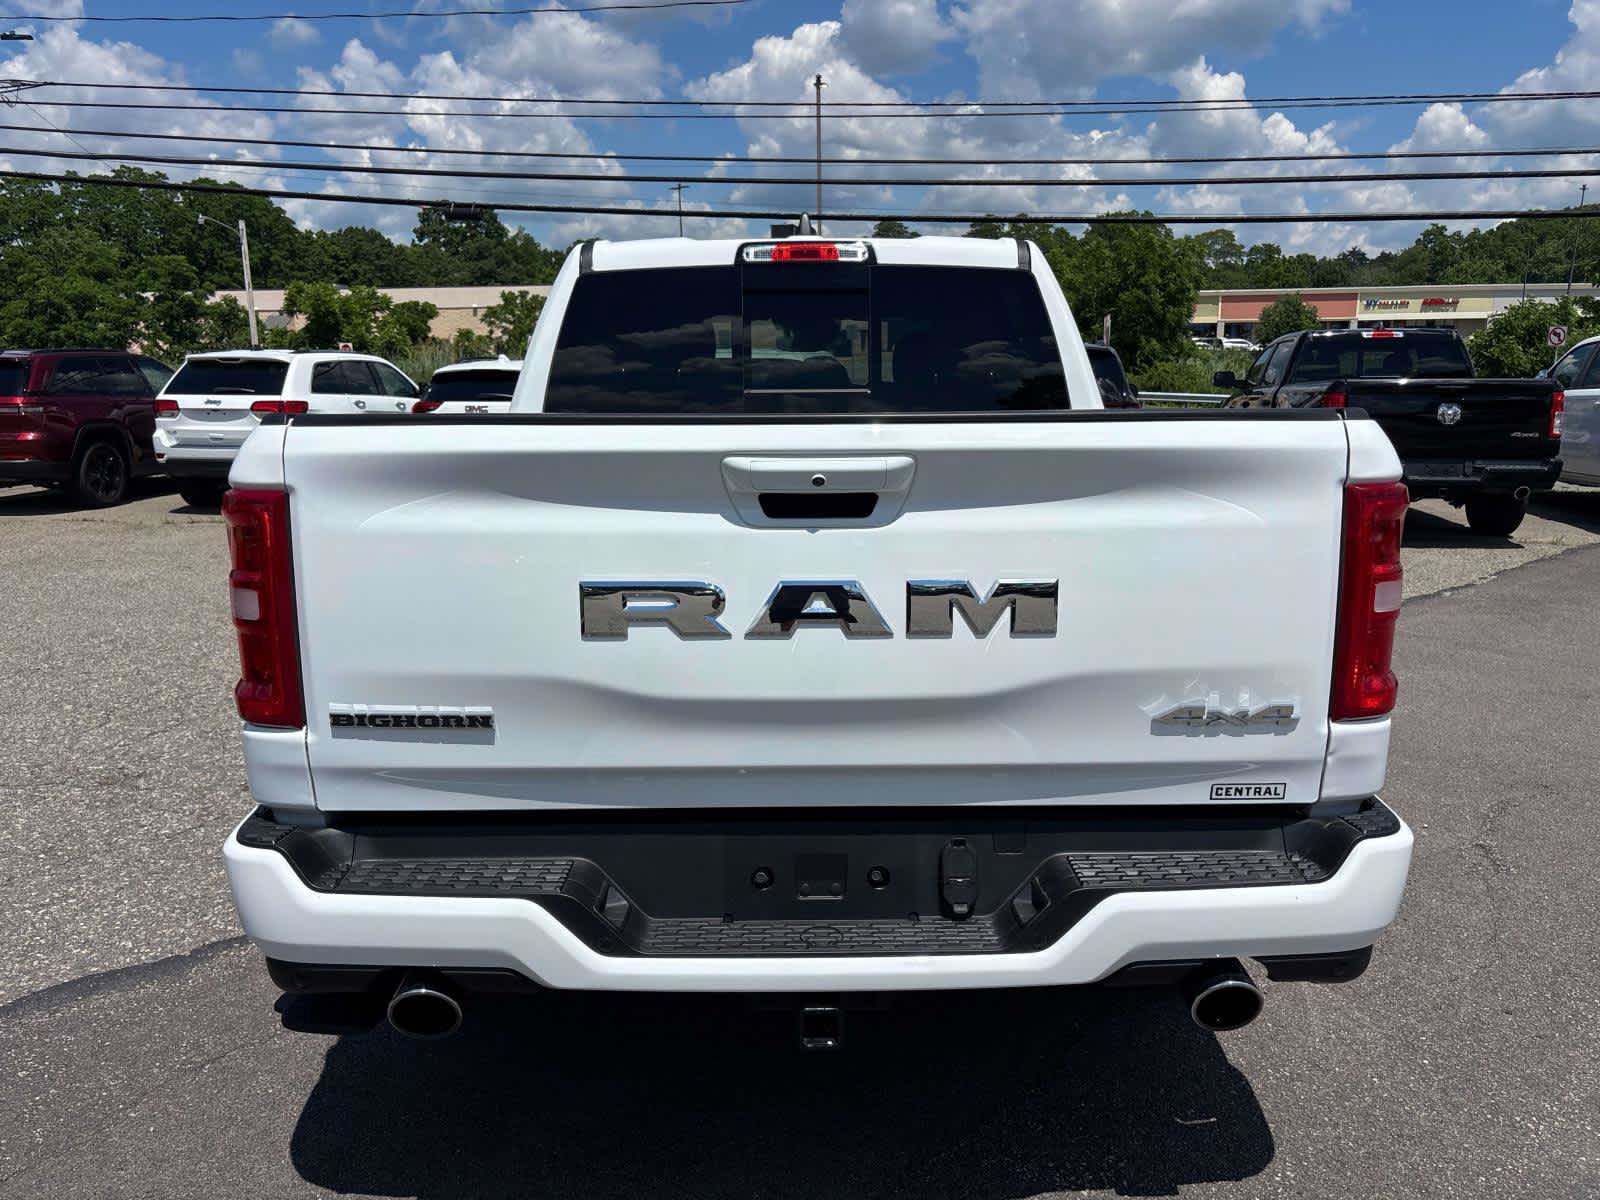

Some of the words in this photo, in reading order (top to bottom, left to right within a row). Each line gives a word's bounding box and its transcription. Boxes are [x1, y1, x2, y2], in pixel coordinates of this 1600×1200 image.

[465, 405, 489, 414] GMC
[579, 580, 1060, 641] RAM
[329, 713, 494, 728] BIGHORN
[1214, 786, 1281, 797] CENTRAL
